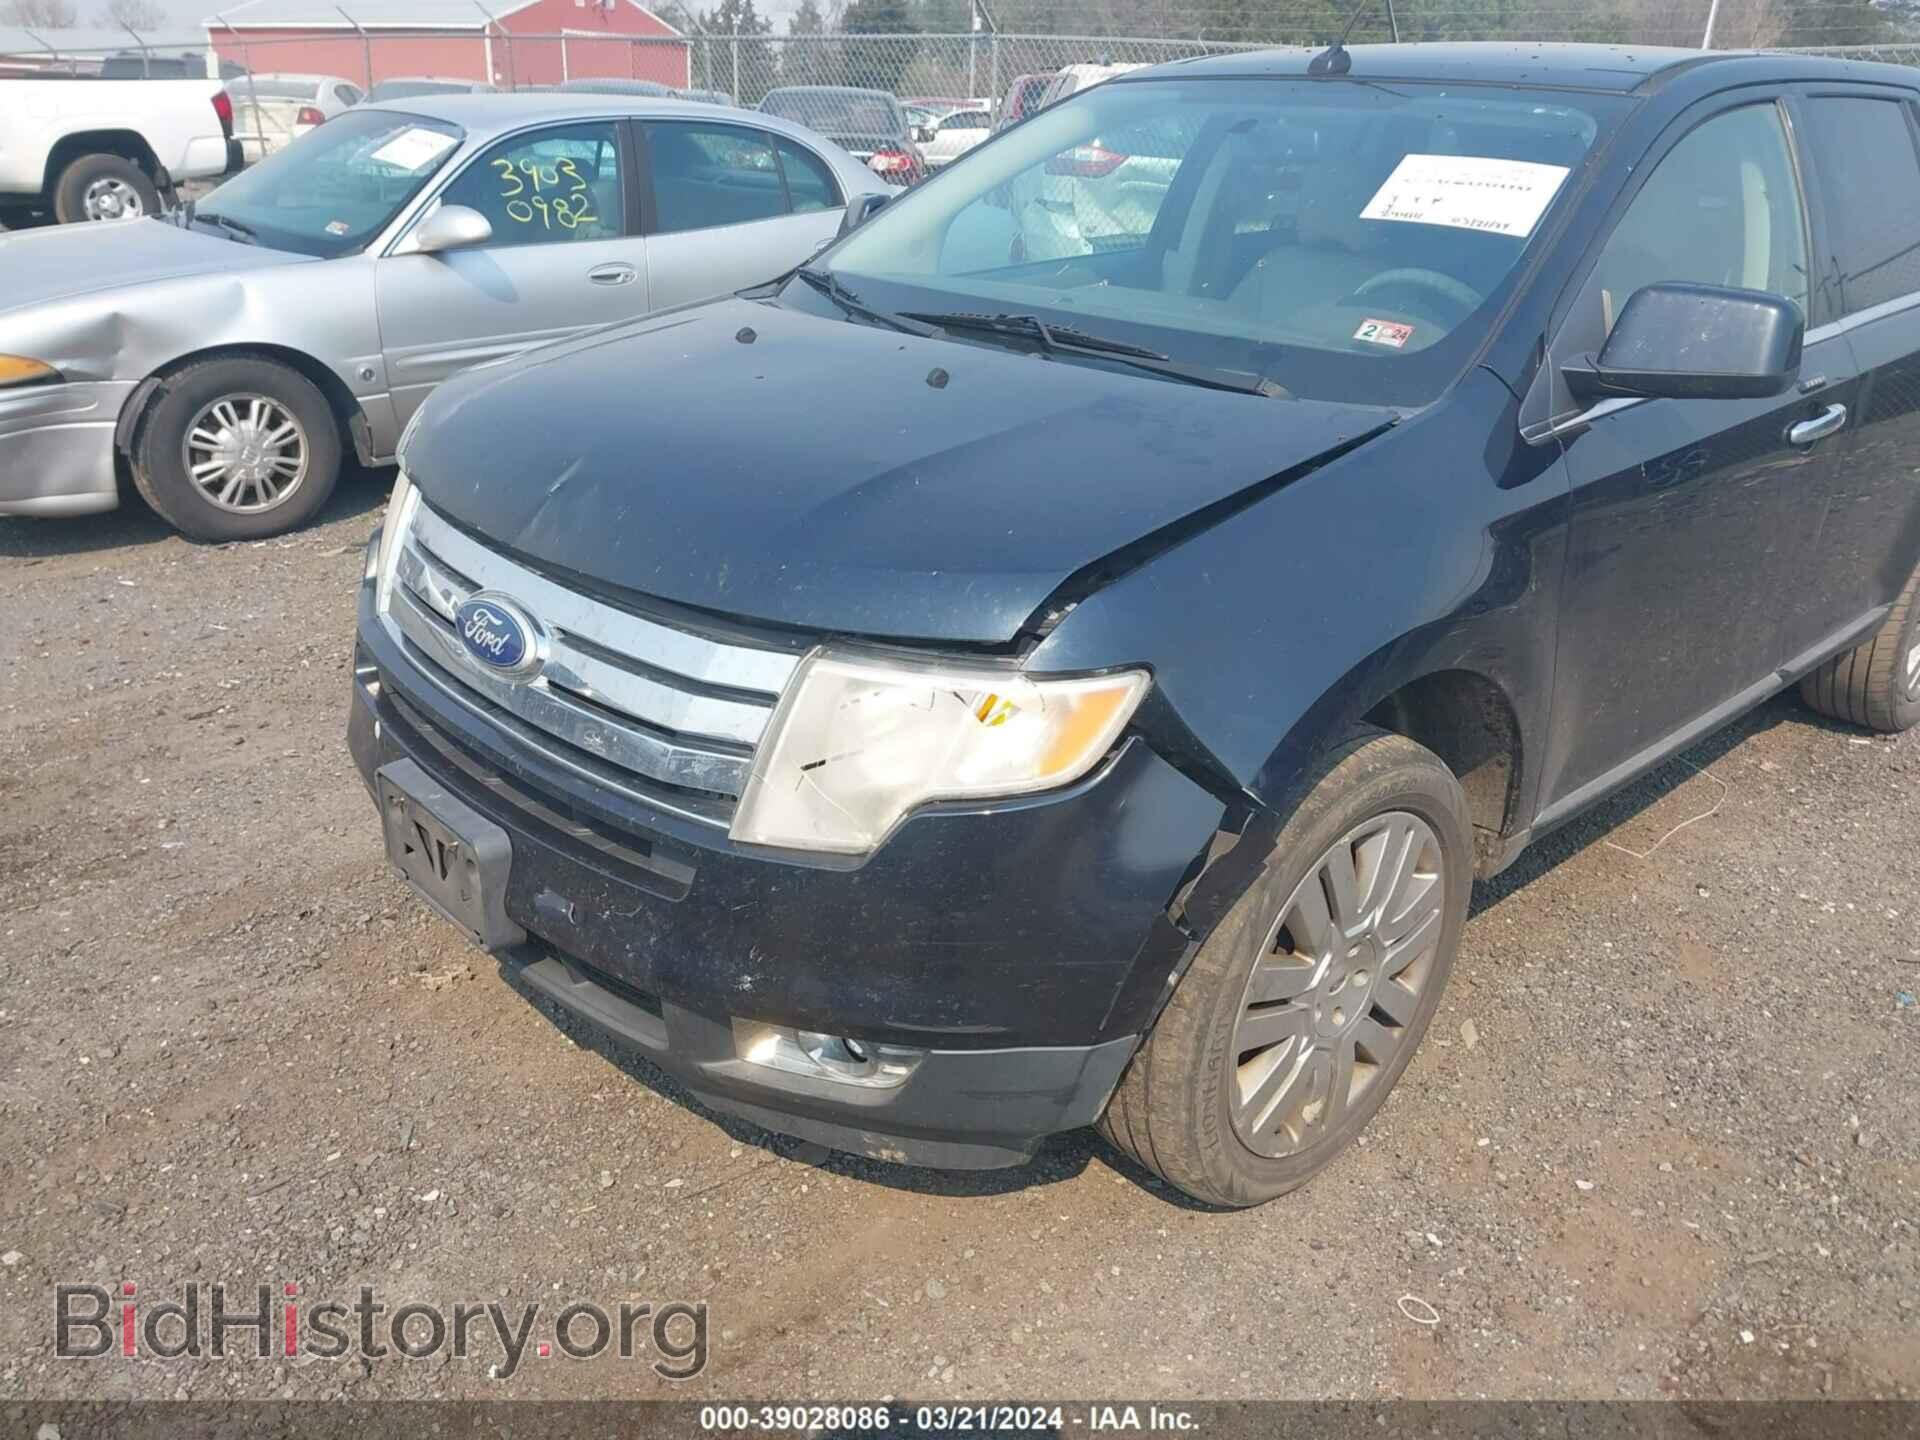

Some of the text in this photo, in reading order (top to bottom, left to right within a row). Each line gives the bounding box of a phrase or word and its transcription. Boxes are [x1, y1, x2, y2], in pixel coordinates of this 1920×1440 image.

[491, 157, 587, 196] 3903
[506, 193, 598, 230] 0982
[1362, 324, 1408, 341] 2 24
[464, 608, 511, 656] Ford
